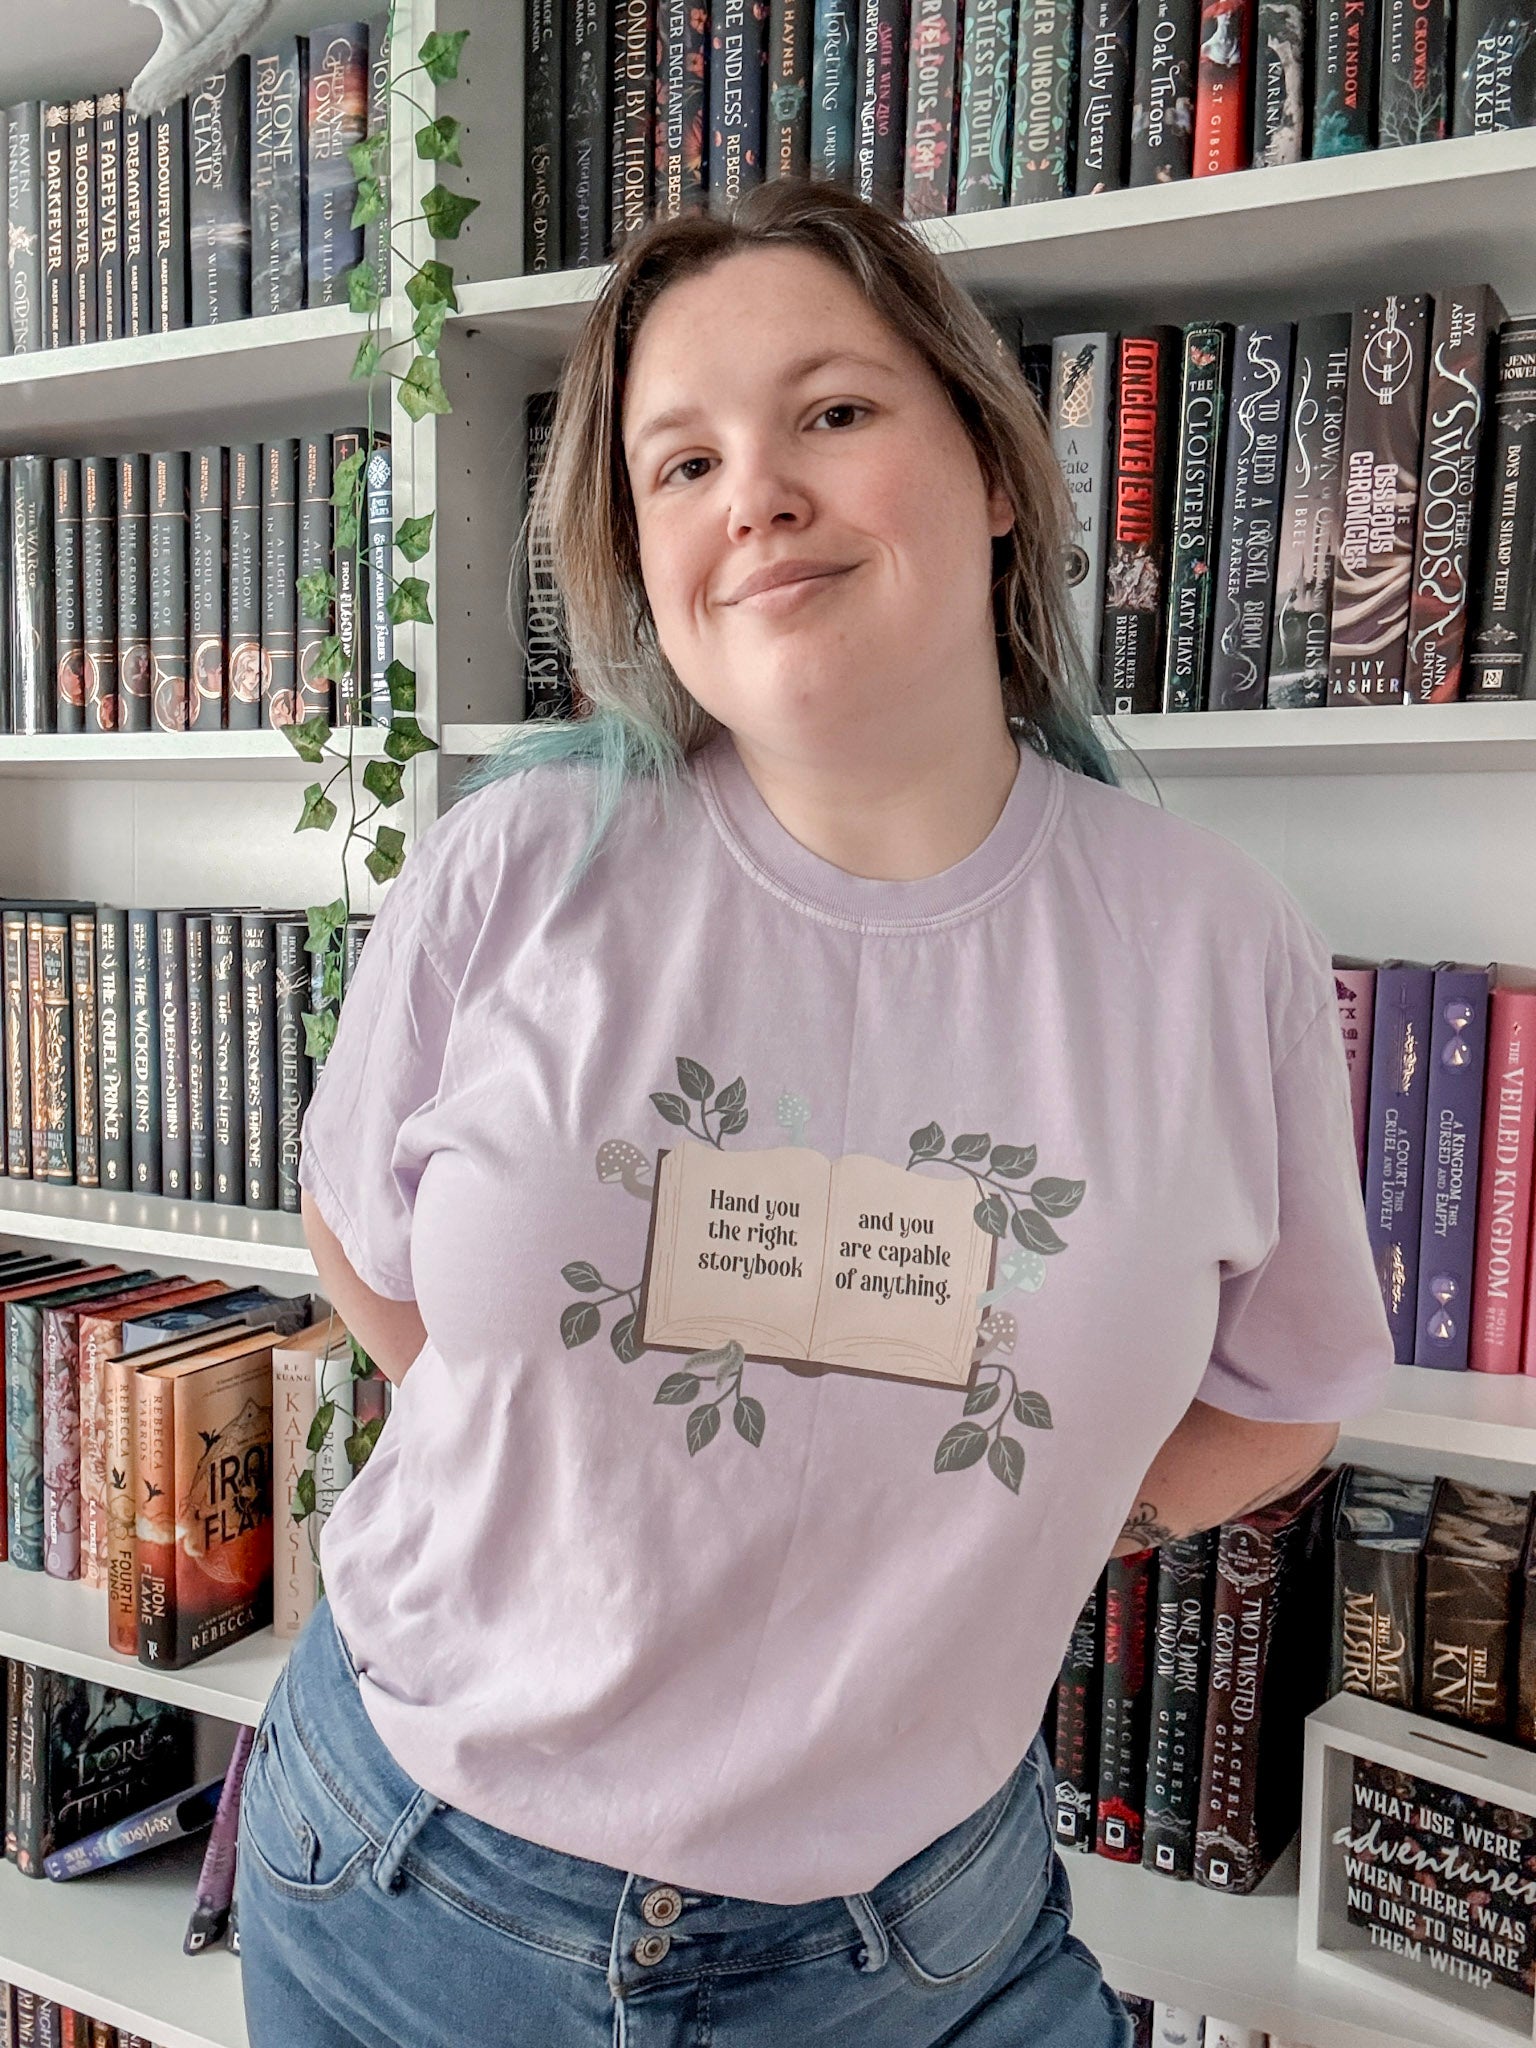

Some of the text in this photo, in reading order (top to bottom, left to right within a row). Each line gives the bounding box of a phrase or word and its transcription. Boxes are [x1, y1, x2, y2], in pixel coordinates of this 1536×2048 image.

[724, 35, 743, 127] ENDLESS
[782, 10, 794, 77] HAYNES
[1328, 12, 1339, 74] GILLIG
[1344, 22, 1360, 110] WINDOW
[1413, 16, 1428, 89] CROWNS
[1495, 34, 1513, 114] SARAH
[271, 68, 295, 165] STONE
[313, 73, 333, 160] TOWER
[625, 91, 645, 121] BY
[668, 43, 683, 149] ENCHANTED
[971, 85, 993, 158] TRUTH
[1028, 47, 1053, 152] UNBOUND
[1084, 32, 1116, 170] Holly Library
[1149, 21, 1181, 147] Oak Throne
[1265, 61, 1281, 136] KARINA
[8, 121, 19, 210] KENNEDY
[19, 133, 30, 193] RAVEN
[191, 93, 213, 186] CHAIR
[204, 73, 227, 192] DRAGONBONE
[914, 118, 936, 181] LIGHT
[47, 150, 62, 275] DARKFEVER
[74, 143, 90, 275] BLOODFEVER
[100, 138, 118, 267] FAEFEVER
[126, 131, 141, 263] DREAMFEVER
[156, 123, 170, 258] SHADOWFEVER
[624, 134, 647, 232] THORNS
[269, 236, 280, 313] WILLIAMS
[323, 225, 335, 303] WILLIAMS
[1449, 303, 1464, 350] ASHER
[1462, 312, 1477, 337] IVY
[1189, 380, 1214, 391] THE
[1320, 347, 1349, 482] THE CROWN
[1116, 337, 1160, 543] LONG LIVE EVIL
[1178, 397, 1213, 550] CLOISTERS
[1226, 457, 1251, 599] SARAH PARKER
[1242, 399, 1280, 650] TO BLEED CRYSTAL BLOOM
[1343, 450, 1376, 571] CHRONICLES
[1369, 462, 1399, 554] OSSEOUS
[1454, 455, 1476, 549] INTO THEIR
[1492, 444, 1522, 612] BOYS WITH SHARP TEETH
[65, 528, 75, 632] FROM BLOOD
[94, 542, 104, 613] KINGDOM
[130, 555, 138, 608] CROWN
[152, 524, 161, 631] TWO QUEENS
[162, 526, 171, 597] THE WAR
[204, 548, 212, 587] SOUL
[232, 575, 240, 623] EMBER
[242, 547, 251, 609] SHADOW
[266, 573, 274, 622] FLAME
[276, 554, 285, 599] LIGHT
[341, 561, 350, 591] FROM
[193, 582, 201, 632] BLOOD
[1176, 587, 1197, 676] KATY HAYS
[1113, 615, 1127, 689] BRENNAN
[1125, 614, 1138, 690] SARAH REES
[1333, 678, 1401, 694] ASHER
[1350, 660, 1385, 677] IVY
[1420, 641, 1437, 700] DENTON
[1434, 653, 1447, 686] ANN
[101, 971, 122, 1141] THE CRUEL PRINCE
[134, 974, 150, 1133] THE WICKED KING
[279, 1024, 302, 1165] CRUEL PRINCE
[248, 1106, 263, 1169] THRONE
[1380, 1109, 1399, 1231] CRUEL AND LOVELY
[1395, 1140, 1410, 1187] COURT
[1434, 1109, 1454, 1237] CURSED AND EMPTY
[1487, 1041, 1524, 1300] THE VEILED KINGDOM
[710, 1189, 800, 1221] Hand you
[1448, 1133, 1466, 1226] KINGDOM THIS
[708, 1220, 798, 1250] the right
[839, 1241, 951, 1268] are capable
[858, 1212, 934, 1238] and you
[698, 1252, 803, 1280] storybook
[835, 1268, 951, 1305] of anything.
[276, 1373, 312, 1382] KUANG
[119, 1383, 129, 1459] REBECCA
[139, 1400, 147, 1462] YARROS
[153, 1395, 163, 1470] REBECCA
[109, 1558, 119, 1601] WING
[120, 1550, 132, 1614] FOURTH
[141, 1565, 153, 1626] FLAME
[151, 1578, 165, 1618] IRON
[191, 1609, 256, 1651] REBECCA
[1157, 1602, 1179, 1679] WINDOW
[1174, 1598, 1202, 1693] ONE DARK
[1212, 1613, 1236, 1691] CROWNS
[1231, 1598, 1263, 1722] TWO TWISTED
[1378, 1614, 1391, 1645] THE
[1473, 1647, 1488, 1679] THE
[1103, 1698, 1118, 1782] GILLIG
[1155, 1710, 1169, 1796] GILLIG
[1170, 1710, 1187, 1804] RACHEL
[1211, 1723, 1226, 1811] GILLIG
[1226, 1724, 1244, 1819] RACHEL
[1331, 1818, 1536, 1905] adventures
[1353, 1783, 1522, 1863] WHAT USE WERE
[1343, 1855, 1526, 1943] WHEN THERE WAS
[1347, 1886, 1520, 1973] NO ONE TO SHARE
[1368, 1922, 1493, 1990] THEM WITH?
